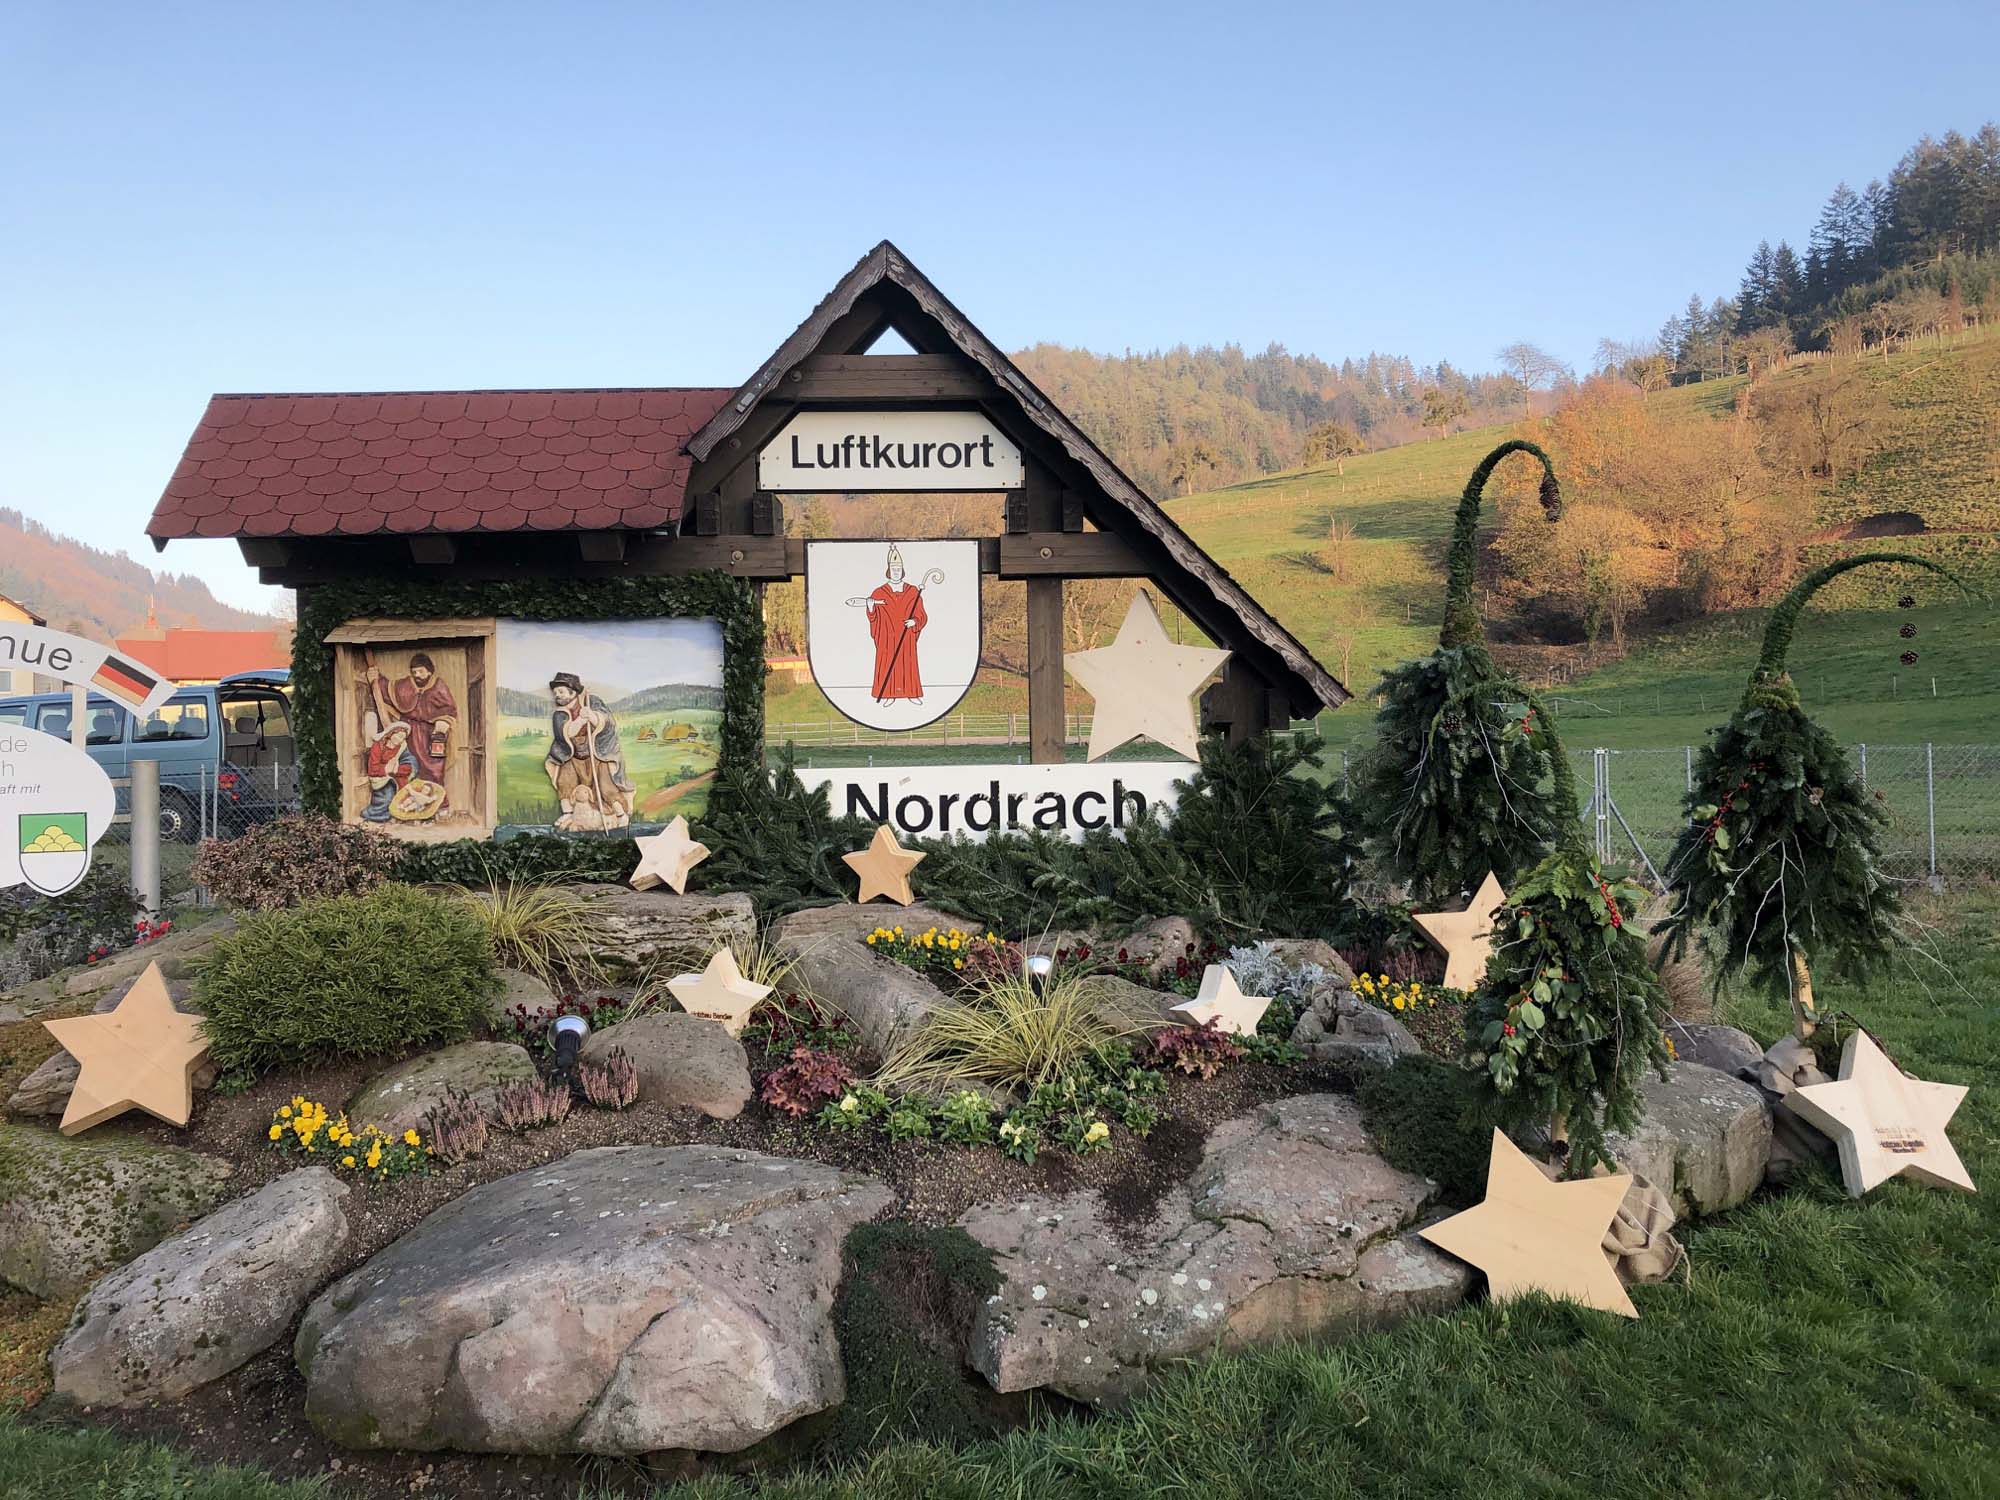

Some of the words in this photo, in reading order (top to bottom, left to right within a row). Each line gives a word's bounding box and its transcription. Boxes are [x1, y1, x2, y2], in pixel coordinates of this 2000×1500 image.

[791, 434, 995, 469] Luftkurort
[20, 783, 42, 795] mit
[846, 778, 1148, 834] Nordrach
